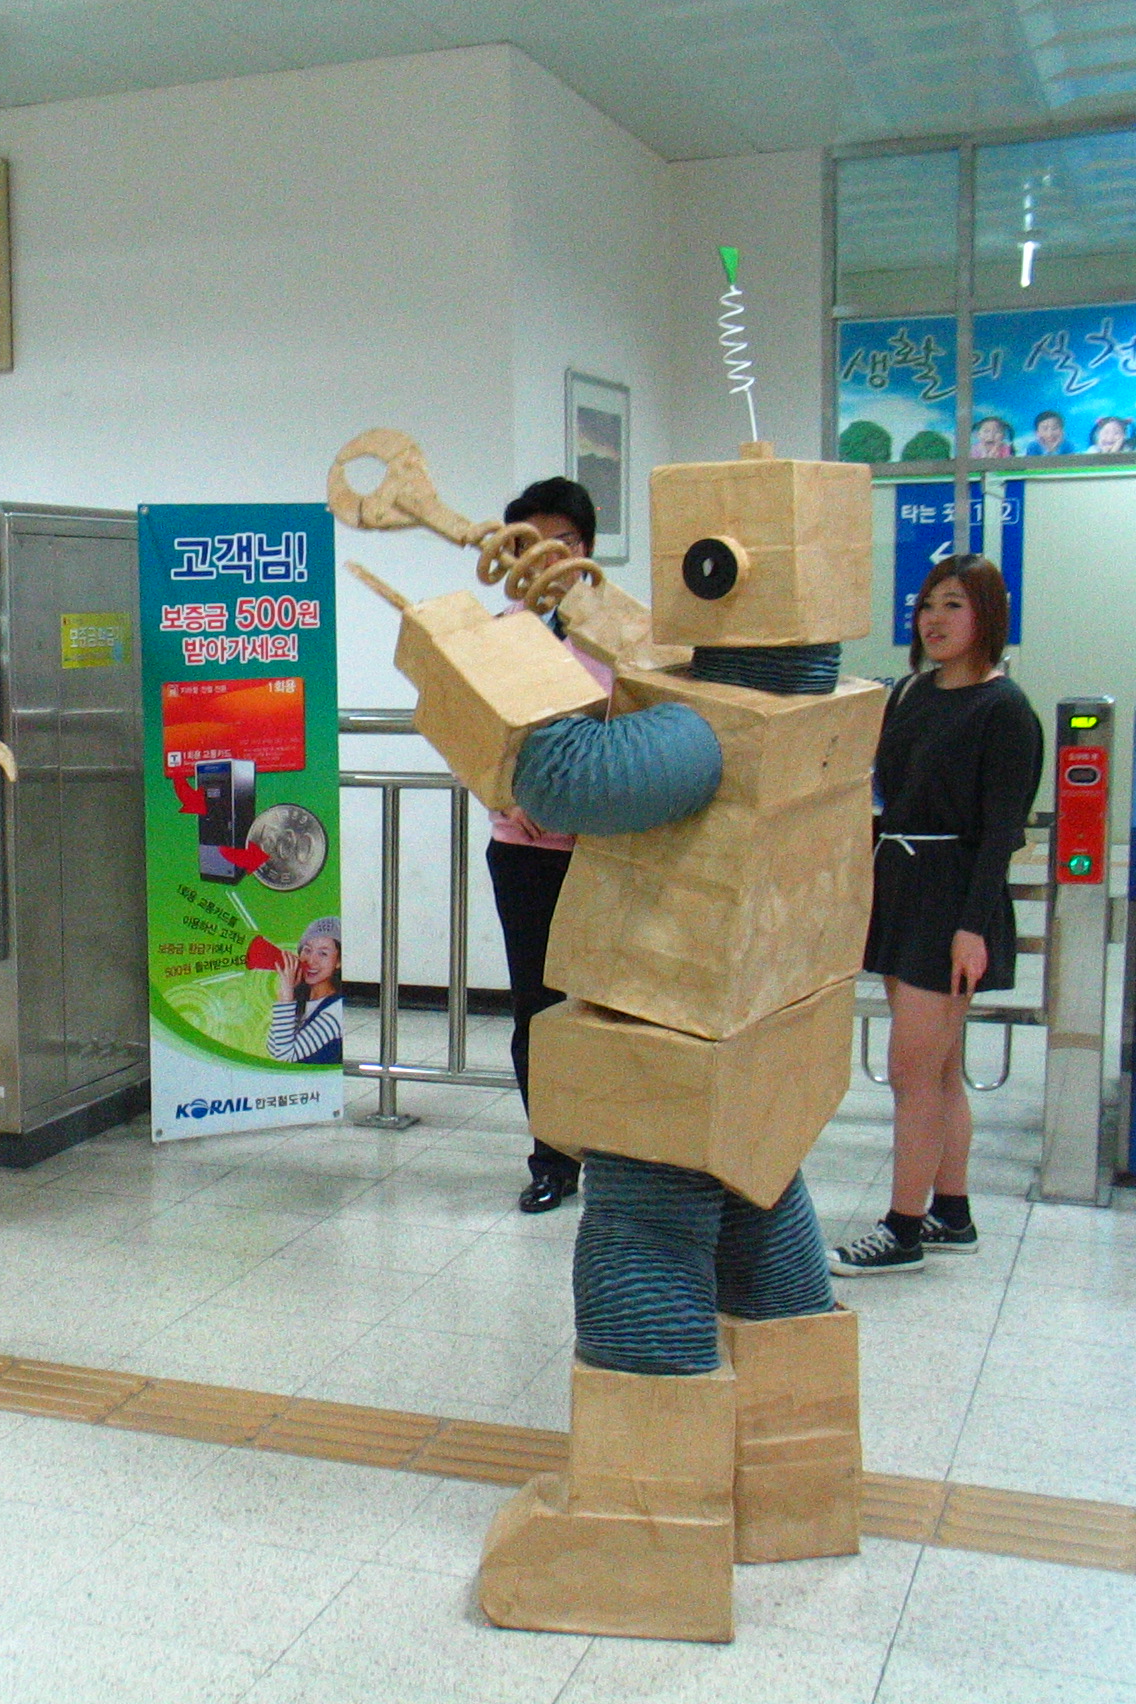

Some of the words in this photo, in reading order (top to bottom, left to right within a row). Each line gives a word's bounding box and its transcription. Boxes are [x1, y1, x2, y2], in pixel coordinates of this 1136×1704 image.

[901, 504, 937, 524] 타는
[1002, 503, 1012, 521] 2
[171, 532, 308, 583] 고객님!
[161, 604, 228, 632] 보증금
[236, 596, 319, 629] 500원
[182, 634, 298, 665] 받아가세요!
[175, 1097, 253, 1119] KORAIL
[255, 1091, 320, 1110] 한국철도공사
